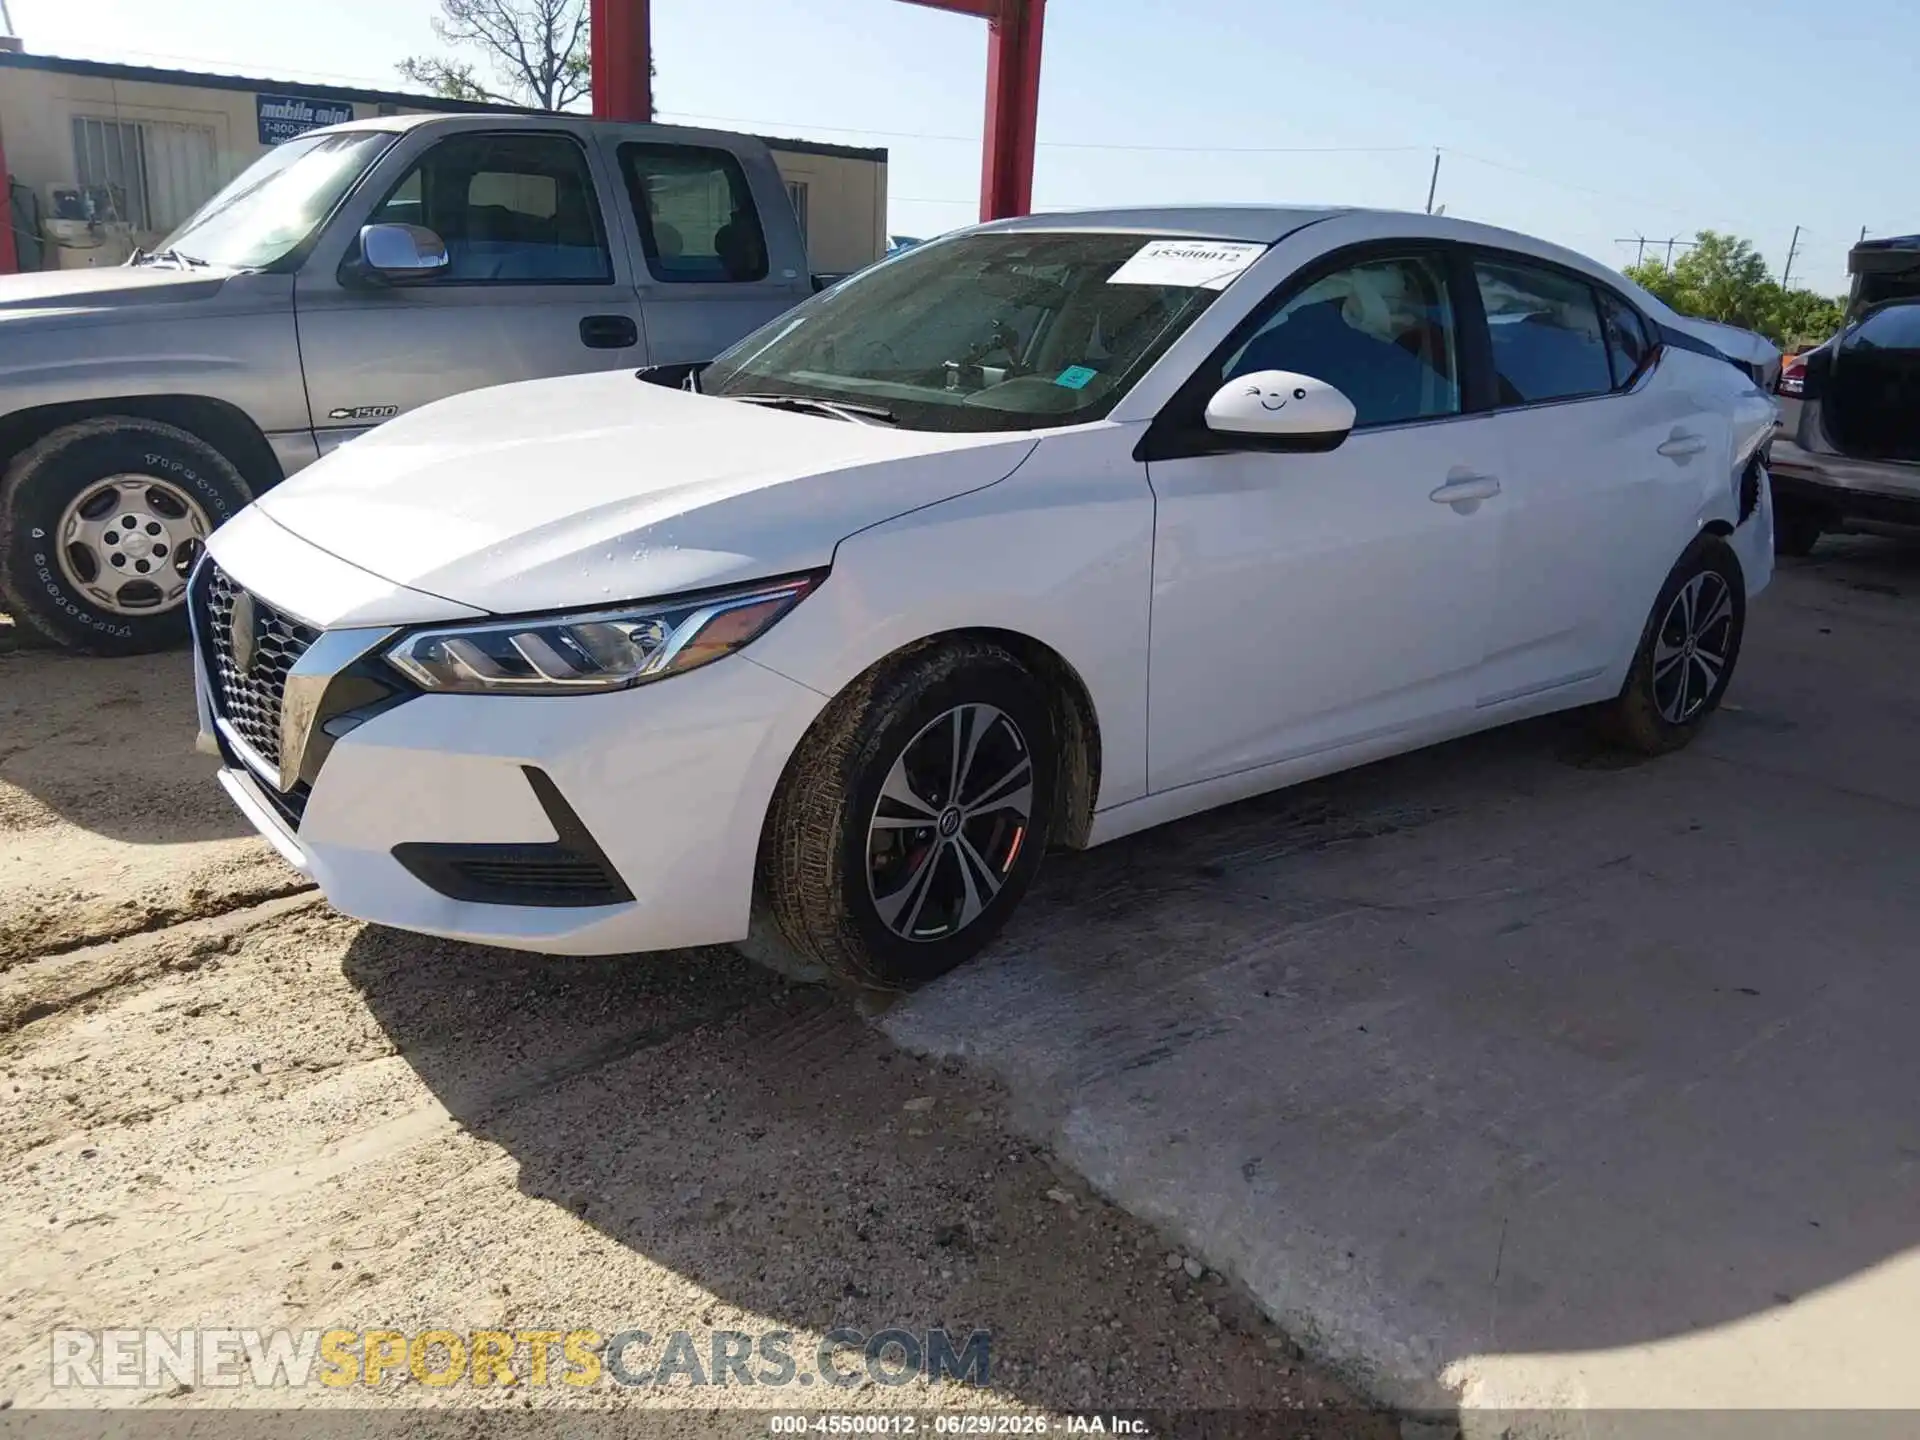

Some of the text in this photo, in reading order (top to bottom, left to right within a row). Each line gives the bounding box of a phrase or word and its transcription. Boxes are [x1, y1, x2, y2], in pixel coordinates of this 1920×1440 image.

[260, 100, 351, 124] mobile mini
[1149, 248, 1241, 262] 45500012
[355, 405, 398, 418] 1500
